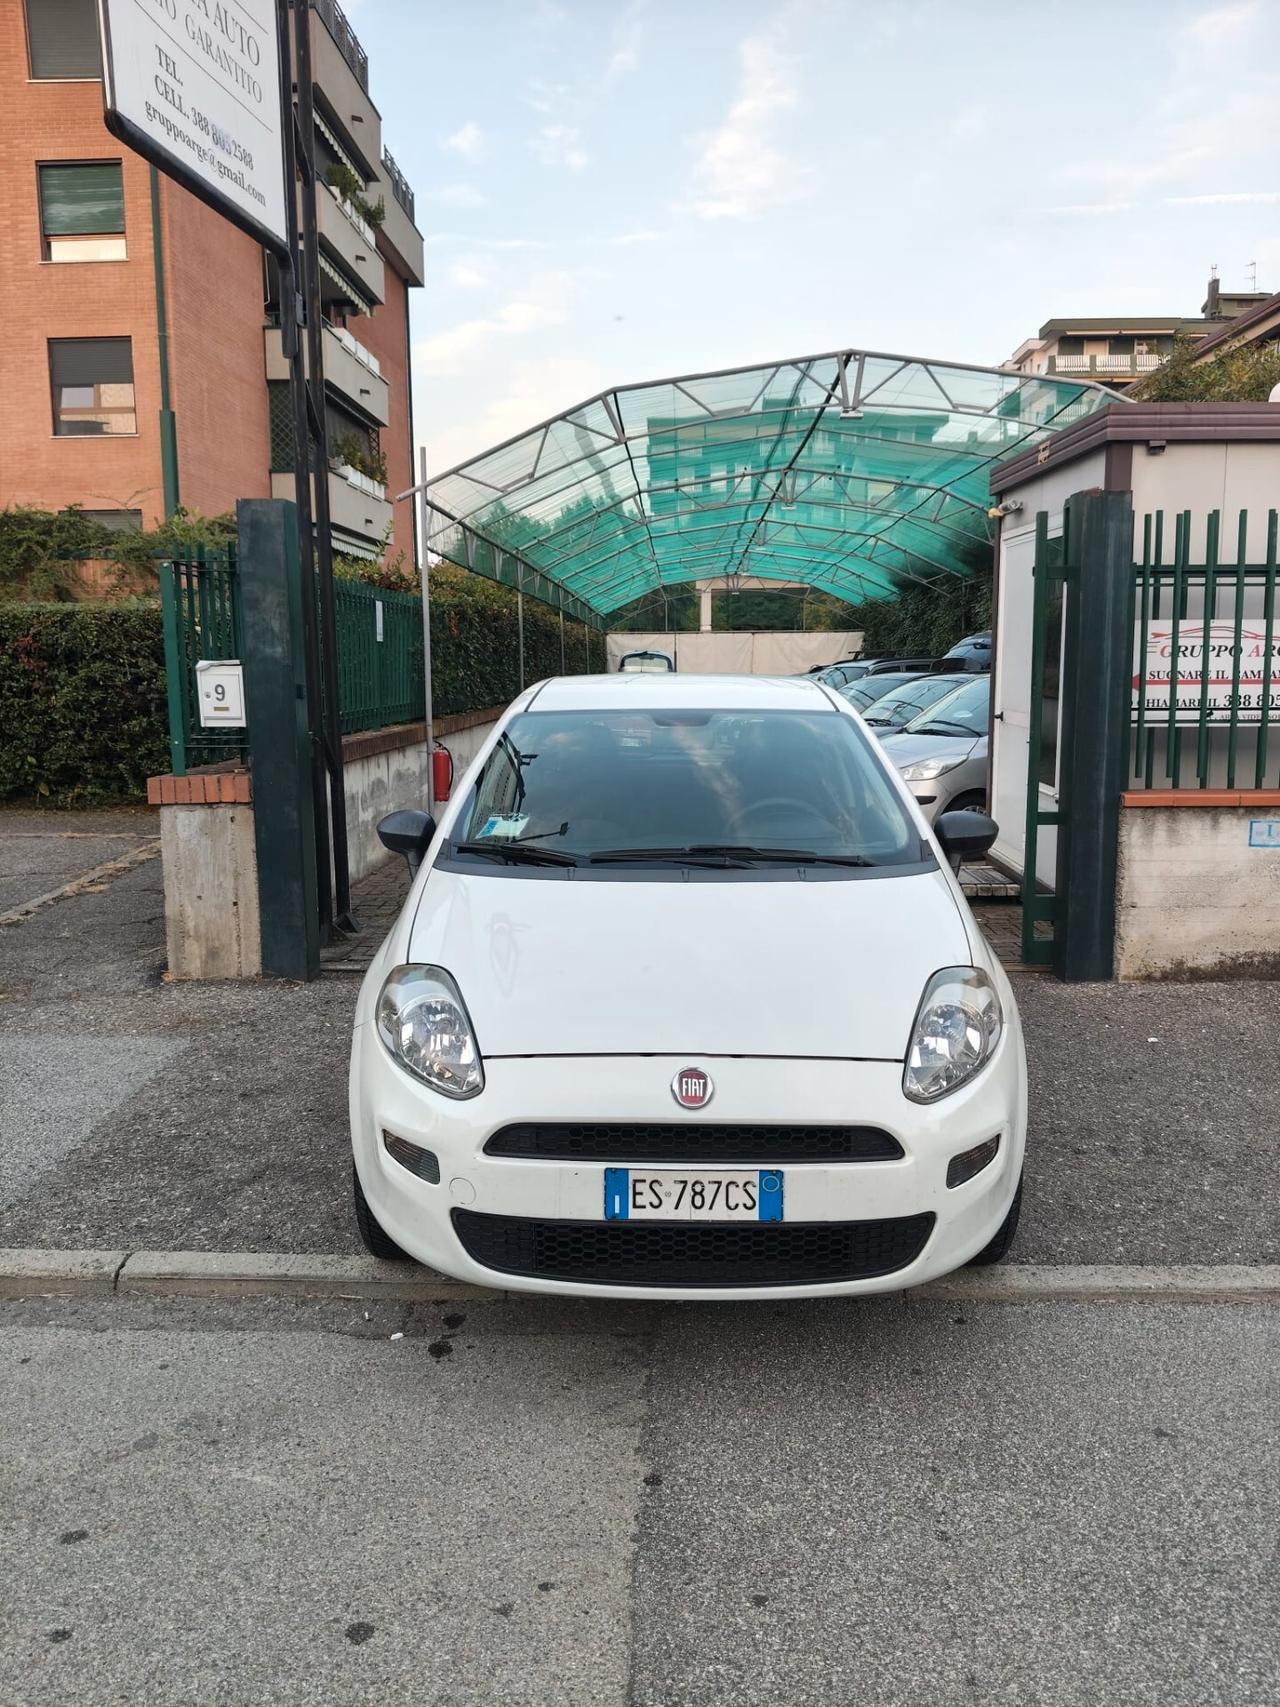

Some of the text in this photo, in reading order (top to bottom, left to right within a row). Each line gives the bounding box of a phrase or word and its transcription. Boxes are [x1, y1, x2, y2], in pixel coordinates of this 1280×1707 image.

[213, 1, 260, 66] AUTO
[155, 43, 184, 86] TEL.
[185, 13, 262, 103] GARANTITO
[154, 74, 190, 119] CELL.
[1248, 644, 1280, 658] AR
[214, 683, 226, 701] 9
[682, 1078, 705, 1097] FIAT
